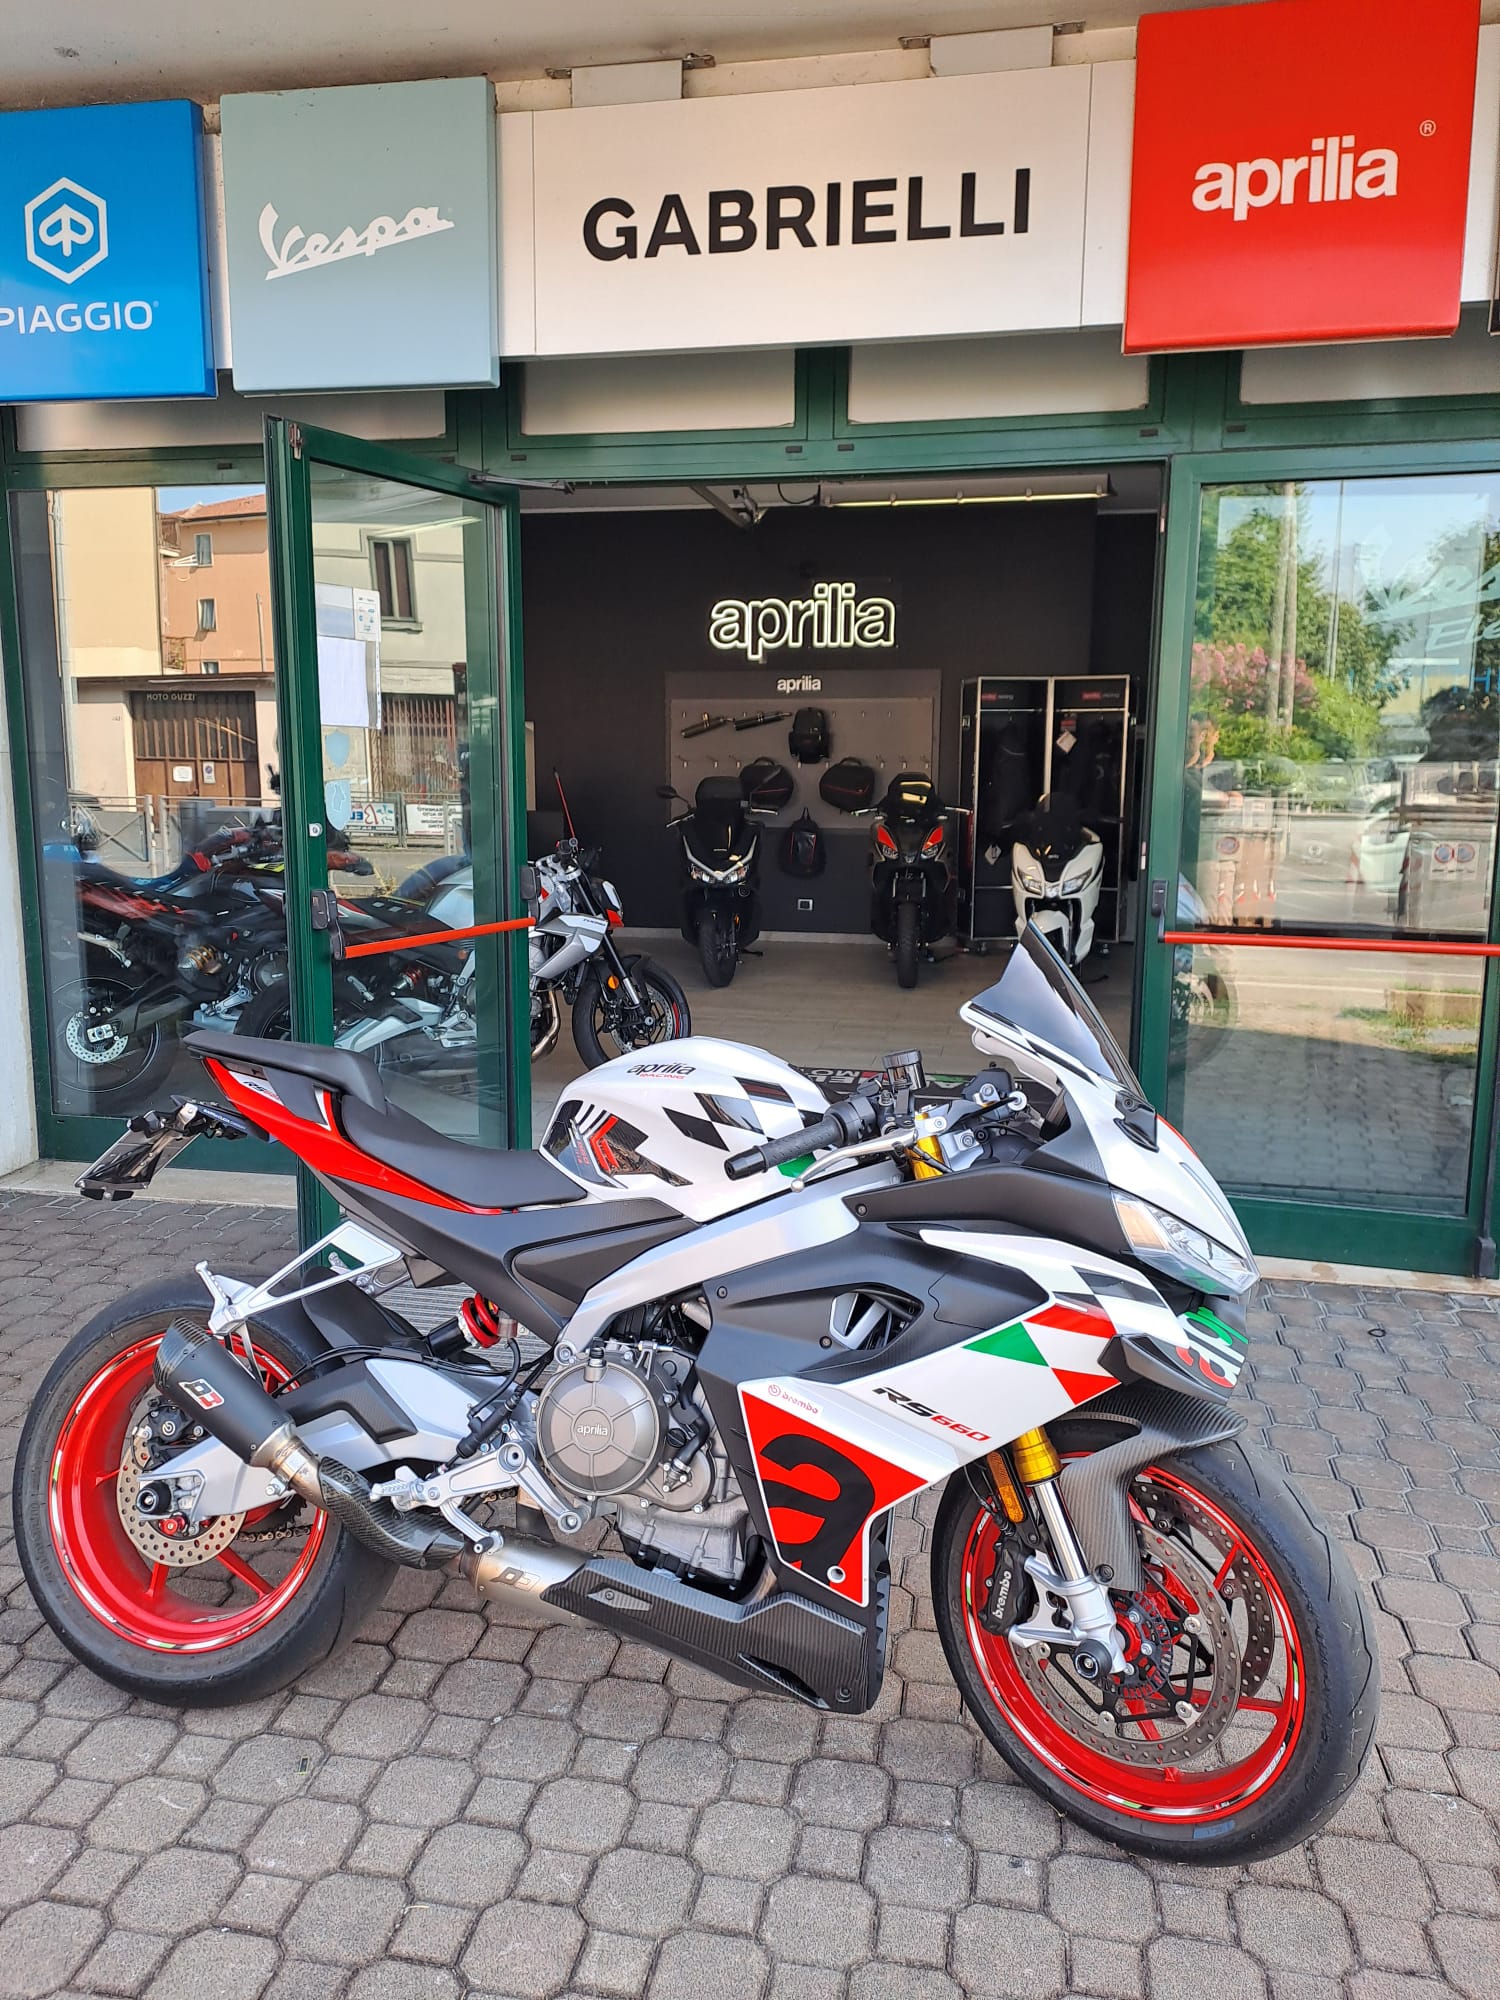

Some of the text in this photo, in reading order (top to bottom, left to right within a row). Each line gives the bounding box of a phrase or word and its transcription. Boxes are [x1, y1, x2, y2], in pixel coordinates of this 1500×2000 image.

[1192, 134, 1398, 221] aprilia
[583, 167, 1030, 262] GABRIELLI
[258, 202, 455, 280] Vespa
[708, 582, 896, 662] aprilia
[146, 693, 196, 701] MOTO GUZZI
[777, 674, 821, 694] aprilia
[626, 1062, 697, 1076] aprilia
[782, 1393, 819, 1414] brembo
[872, 1386, 990, 1441] RS660
[577, 1423, 608, 1436] aprilia
[992, 1570, 1012, 1619] brembo
